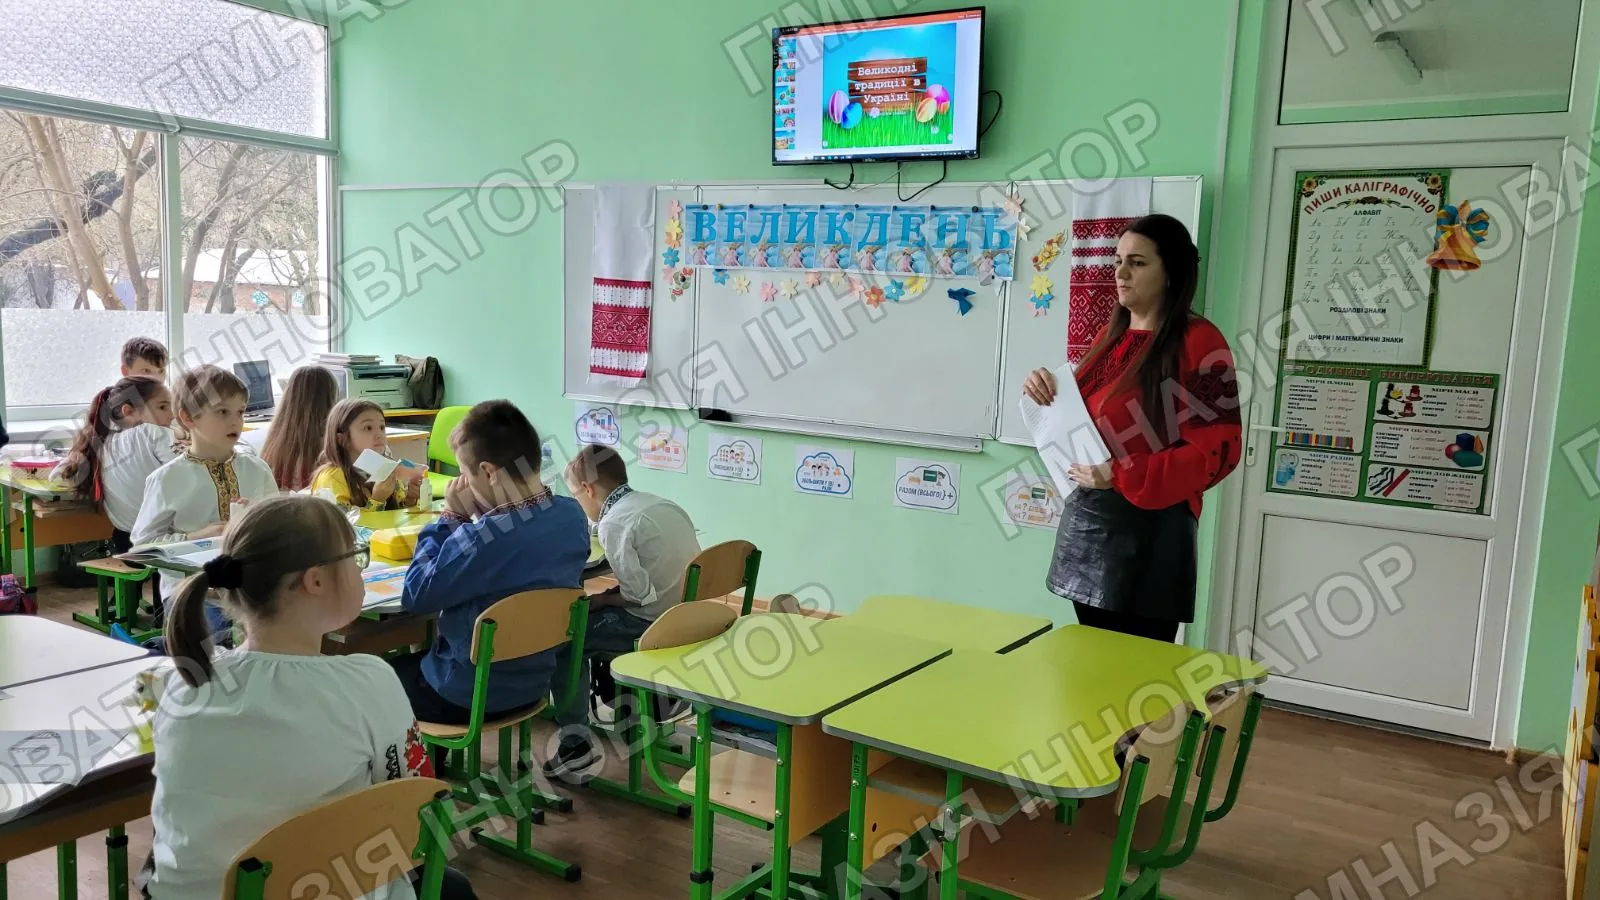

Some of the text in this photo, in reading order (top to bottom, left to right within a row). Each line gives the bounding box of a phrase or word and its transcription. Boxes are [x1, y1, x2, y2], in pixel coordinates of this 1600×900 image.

[857, 62, 917, 76] Великодні
[854, 78, 921, 92] традиції в
[863, 92, 910, 104] Україні
[1303, 181, 1436, 215] ПИШИ КАЛІГРАФІЧНО
[692, 210, 1011, 251] ВЕЛИКДЕНЬ
[1335, 335, 1381, 343] МАТЕМАТИЧНІ
